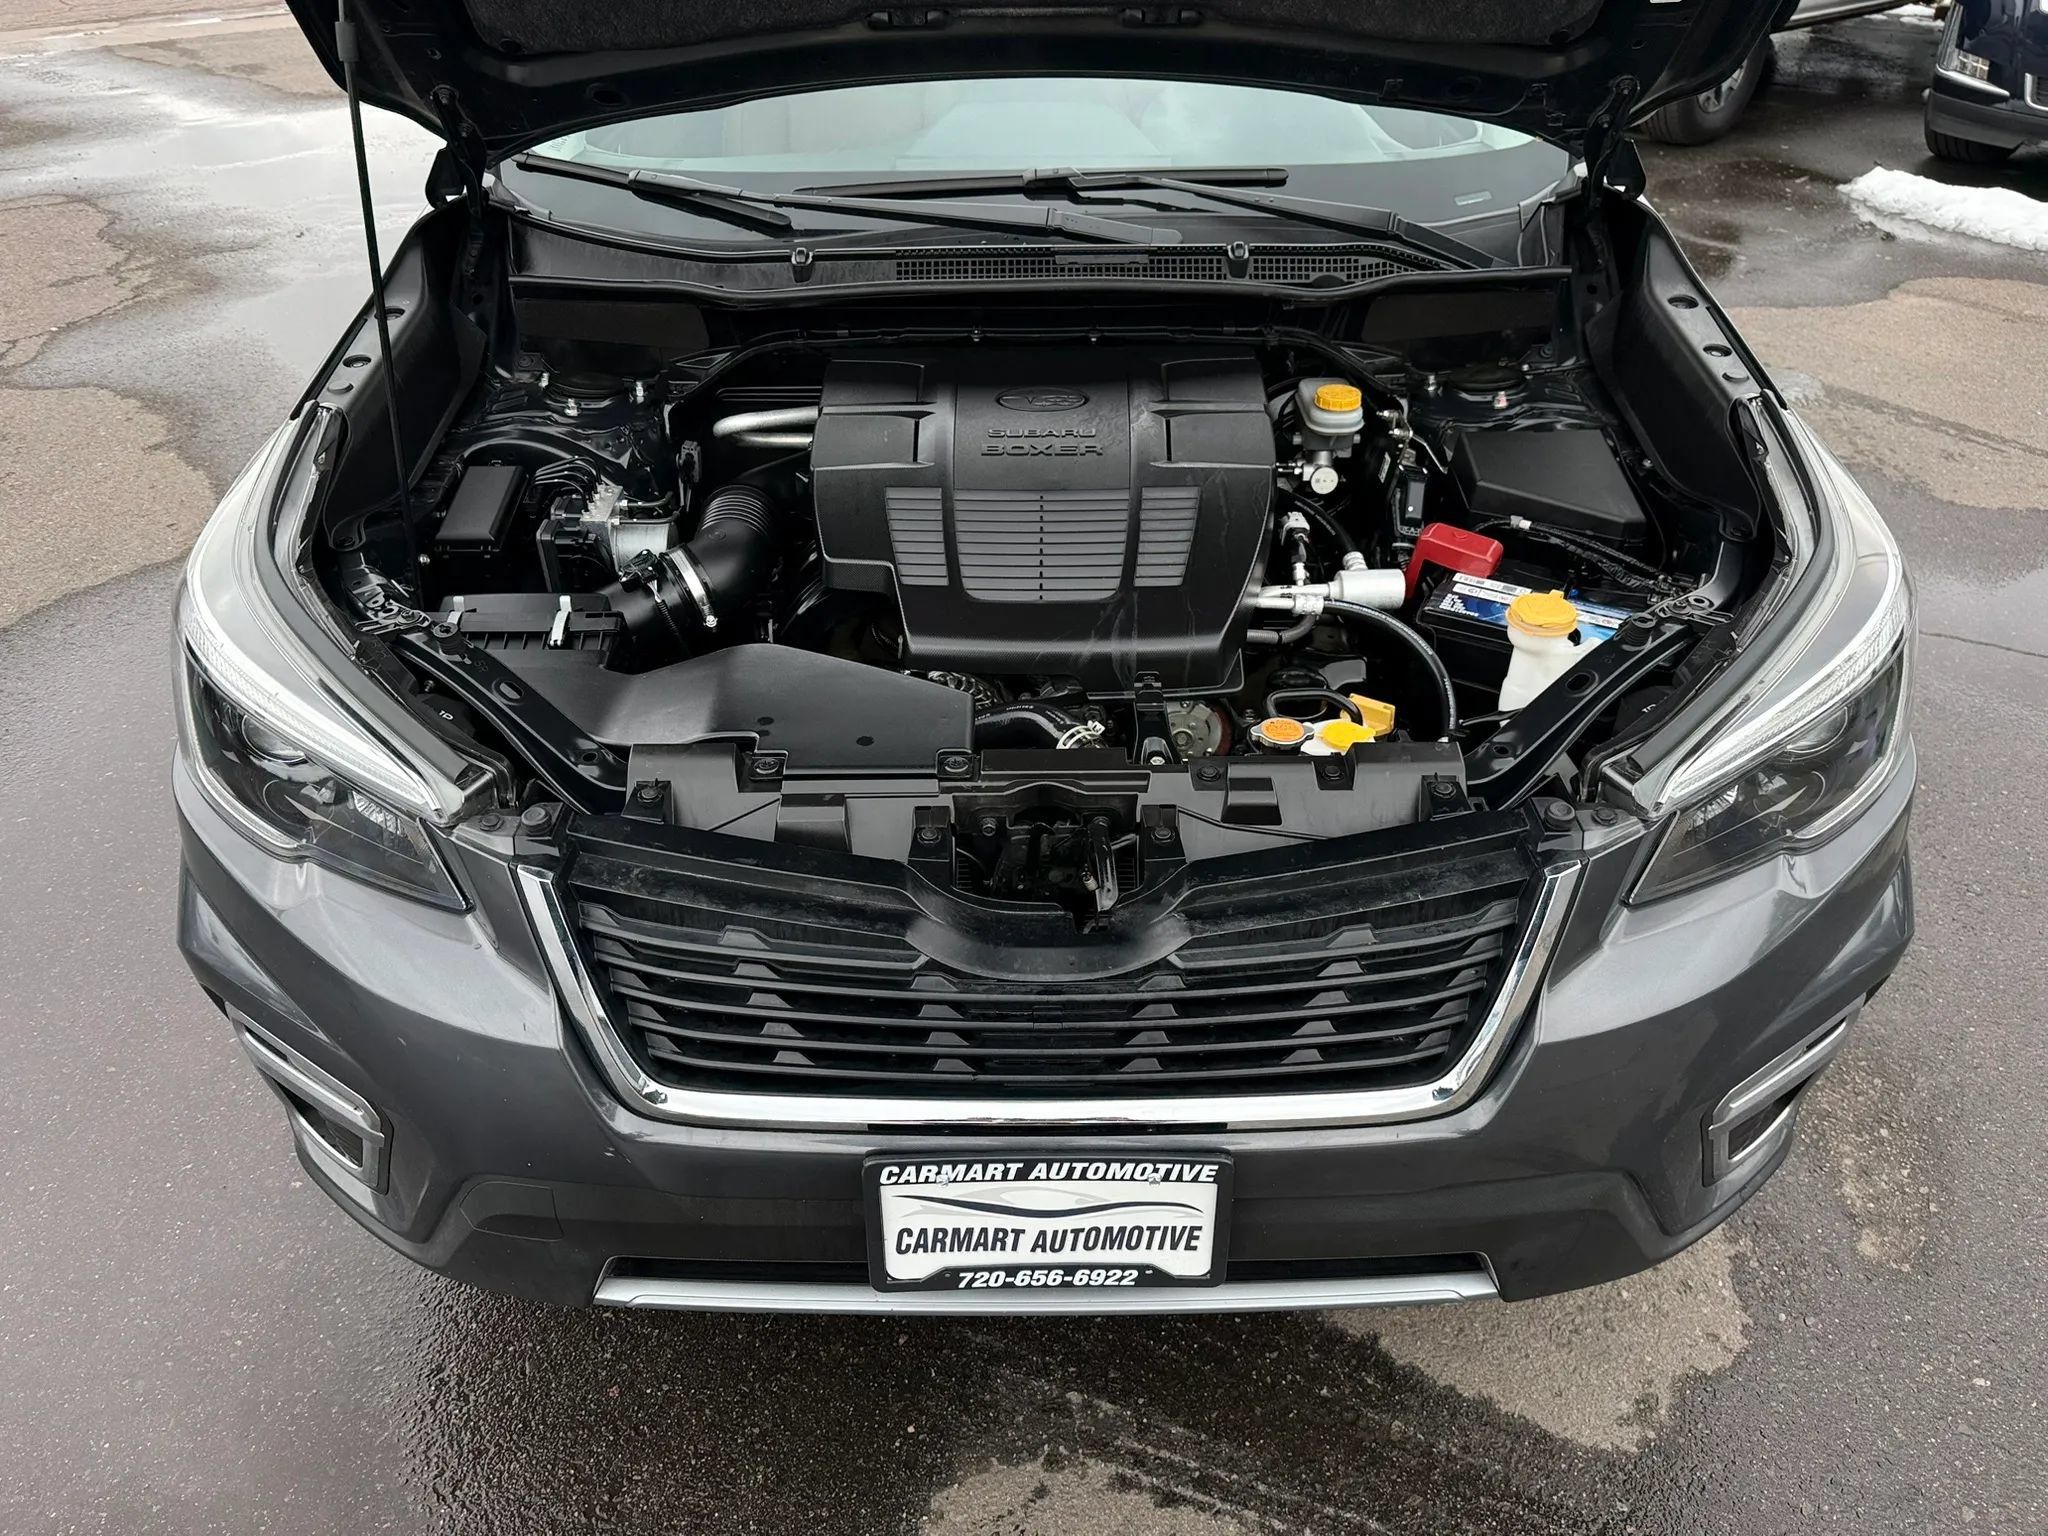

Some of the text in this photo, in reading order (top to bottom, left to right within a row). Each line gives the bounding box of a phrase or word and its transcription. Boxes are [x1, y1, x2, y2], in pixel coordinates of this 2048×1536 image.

[988, 428, 1097, 438] SUBARU
[981, 443, 1104, 456] BOXER
[879, 1162, 1218, 1184] CARMART AUTOMOTIVE
[895, 1225, 1203, 1255] CARMART AUTOMOTIVE
[958, 1269, 1139, 1288] 720-656-6922
